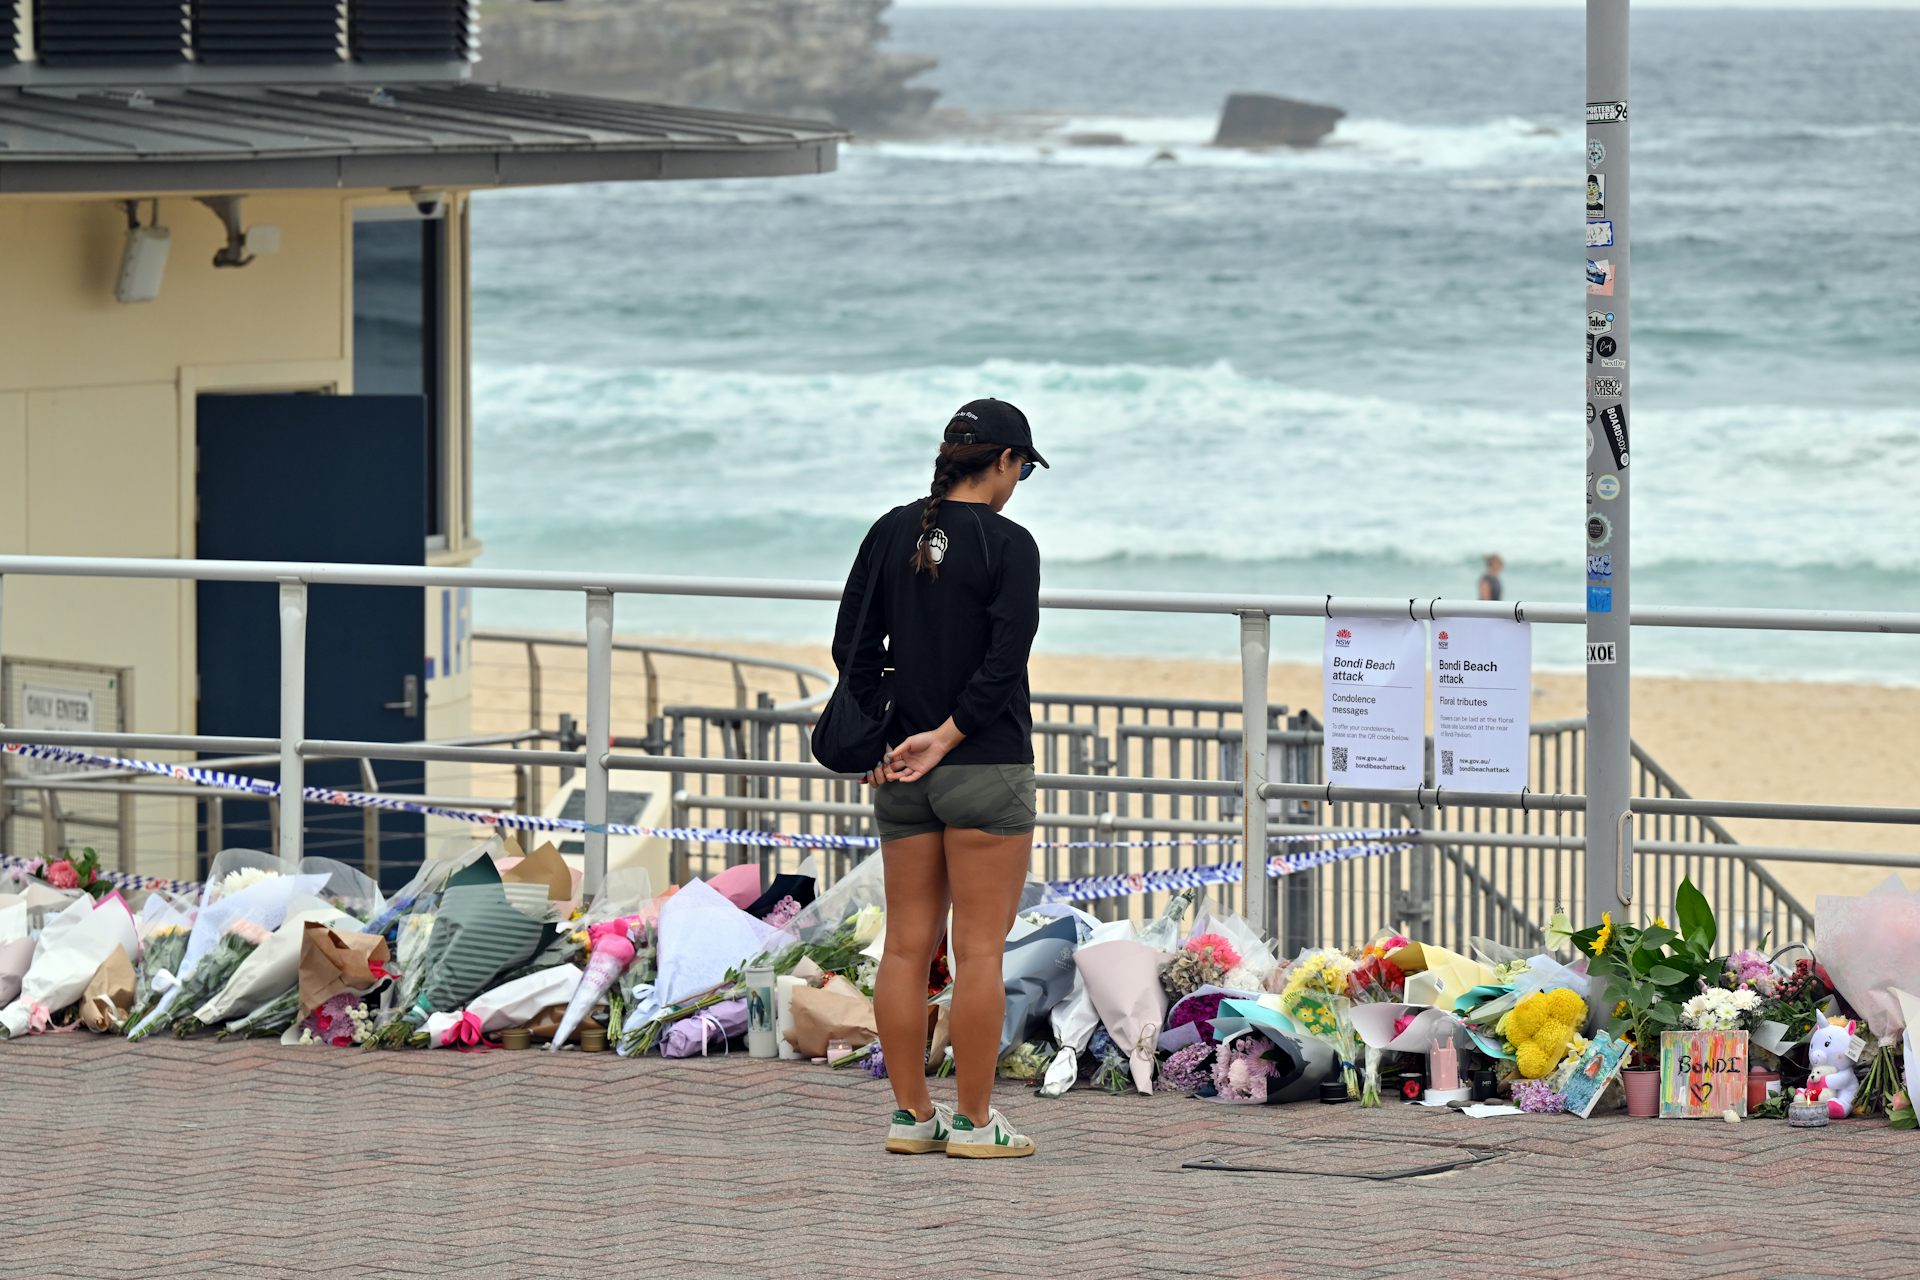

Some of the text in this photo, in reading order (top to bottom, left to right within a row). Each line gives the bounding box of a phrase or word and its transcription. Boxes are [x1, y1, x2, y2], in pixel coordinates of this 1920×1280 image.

[1616, 104, 1627, 118] 96
[1588, 316, 1606, 326] Take
[1606, 407, 1626, 452] BOARDSOX
[1334, 657, 1395, 670] Bondi Beach
[1440, 660, 1497, 672] Bondi Beach
[1332, 671, 1364, 681] attack
[1440, 674, 1464, 684] attack
[1332, 693, 1376, 703] Condolence
[1440, 697, 1487, 706] Floral tributes
[27, 696, 88, 722] ONLY ENTER
[1332, 706, 1368, 716] messages
